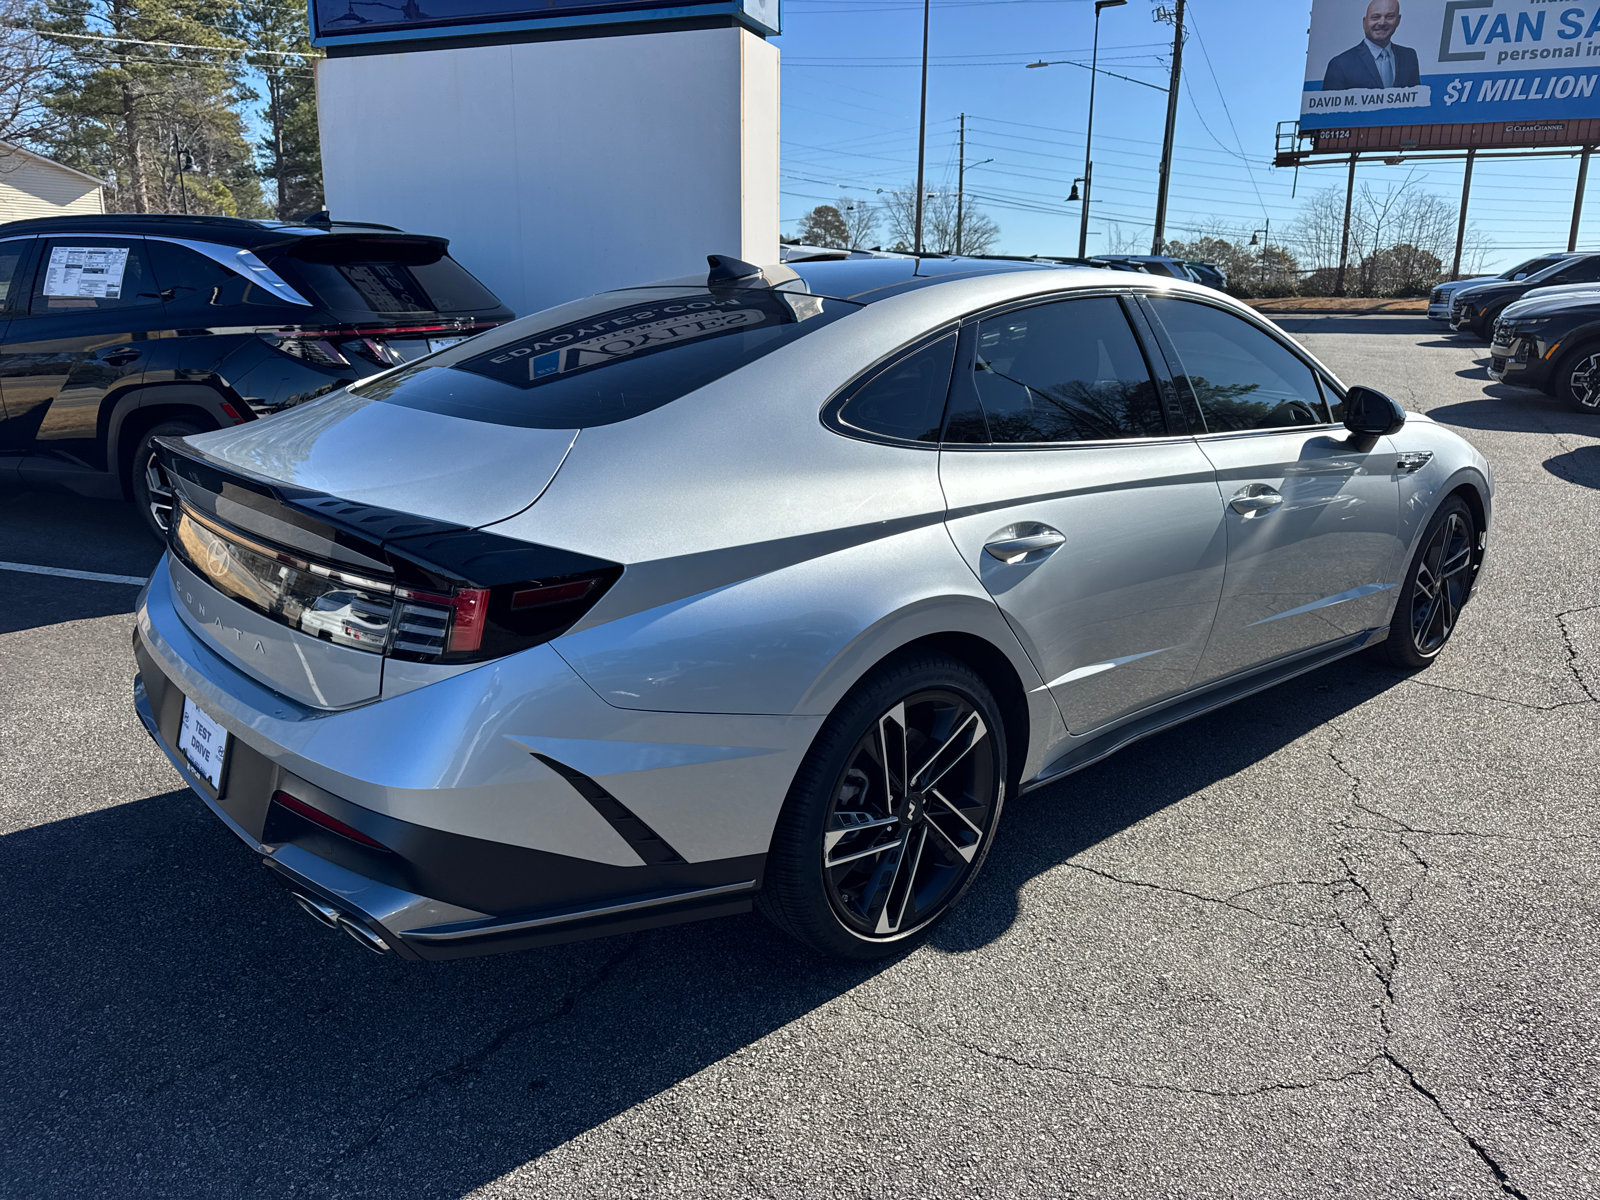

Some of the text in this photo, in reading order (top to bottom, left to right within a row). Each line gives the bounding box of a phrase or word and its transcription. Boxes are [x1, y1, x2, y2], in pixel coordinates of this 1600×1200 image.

[1461, 11, 1546, 45] VAN
[1497, 42, 1581, 65] personal
[1309, 92, 1418, 108] DAVID M. VAN SANT
[1444, 74, 1597, 106] $1 MILLION
[176, 581, 266, 655] SONATA
[195, 720, 212, 743] TEST
[190, 735, 211, 762] DRIVE
